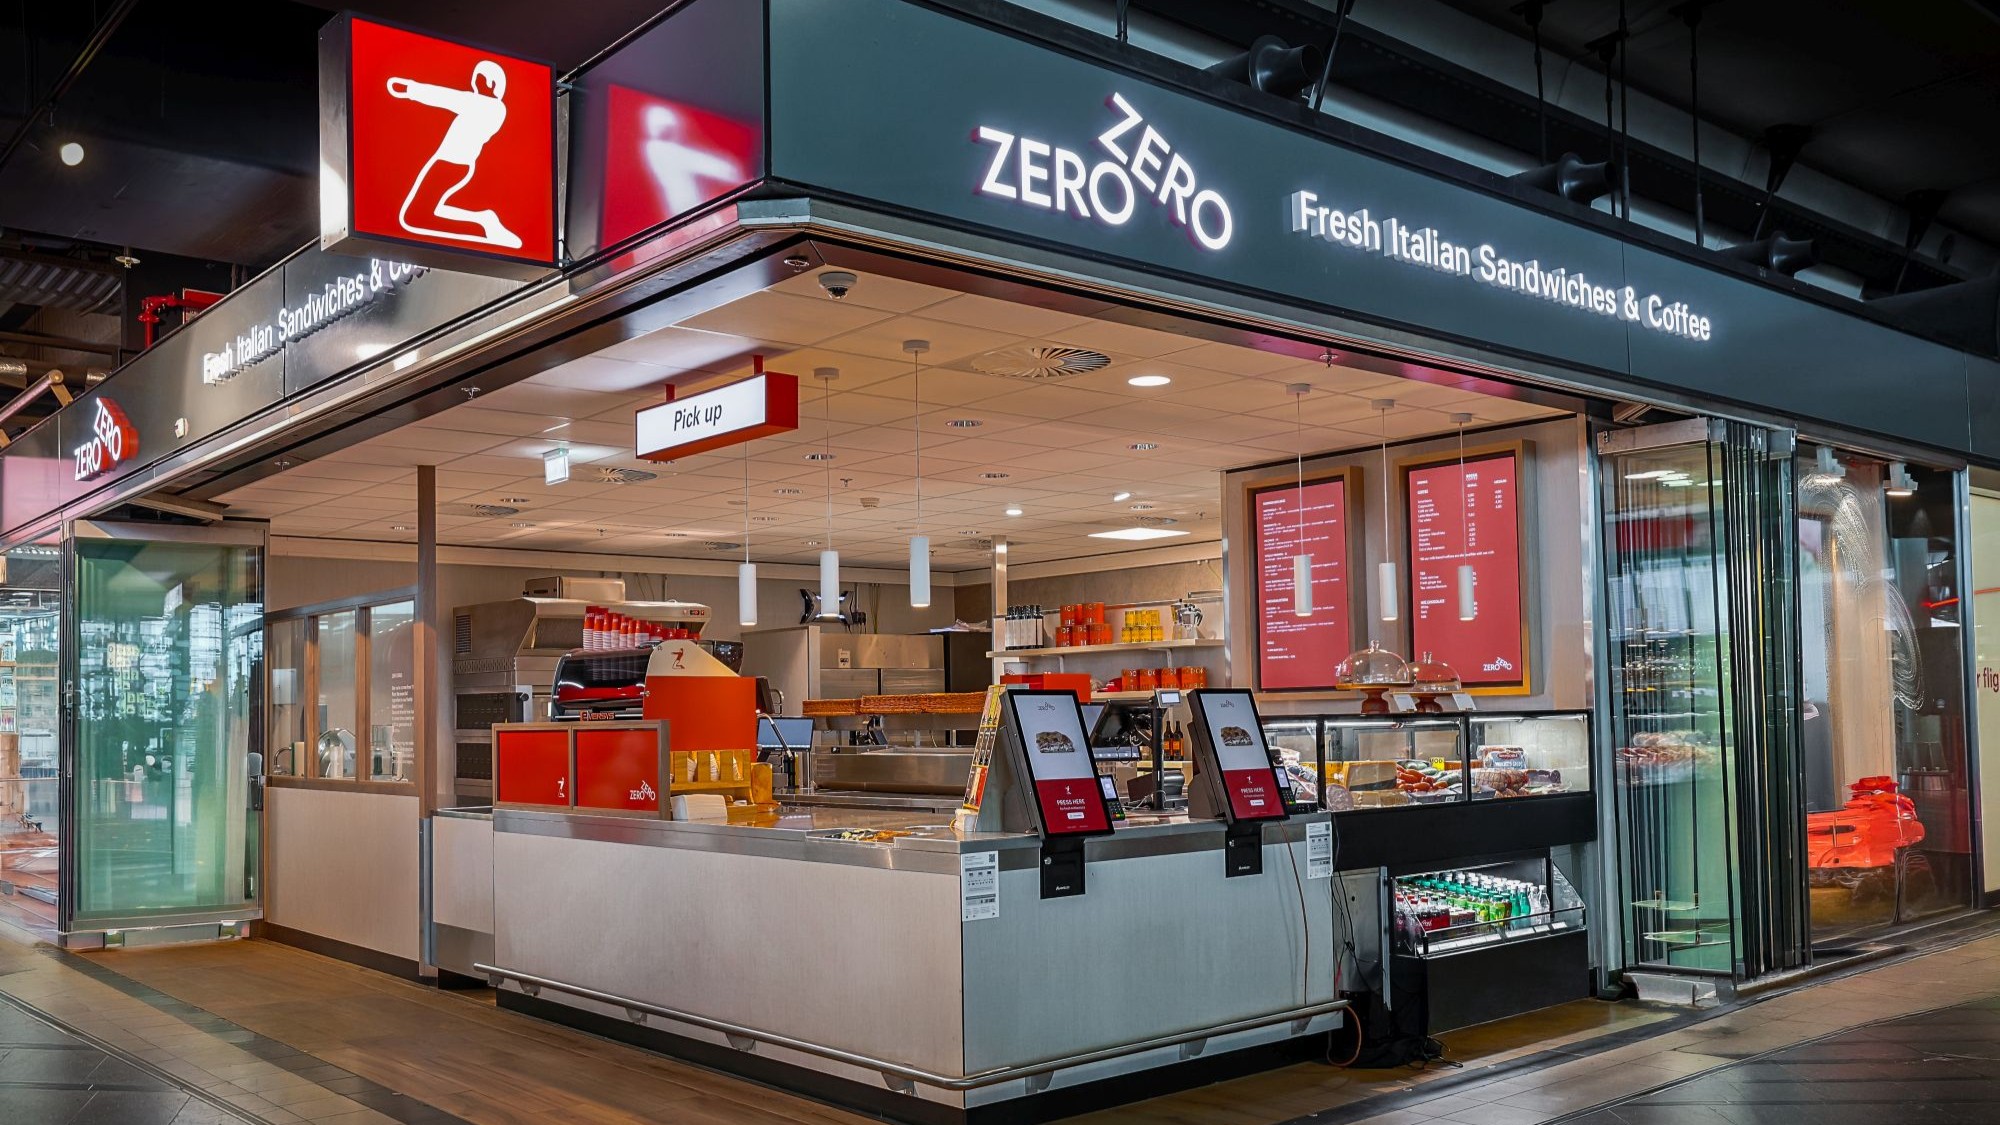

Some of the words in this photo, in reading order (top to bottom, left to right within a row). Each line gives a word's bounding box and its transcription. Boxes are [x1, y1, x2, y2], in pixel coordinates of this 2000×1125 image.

[978, 125, 1135, 225] ZERO
[1097, 91, 1233, 250] ZERO
[1294, 190, 1381, 251] Fresh
[1385, 217, 1471, 276] Italian
[1475, 244, 1617, 315] Sandwiches
[1623, 285, 1641, 321] &
[1645, 295, 1711, 341] Coffee
[236, 324, 273, 367] Italian
[278, 271, 364, 343] Sandwiches
[369, 258, 383, 293] &
[74, 436, 102, 481] ZERO
[93, 397, 122, 462] ZERO
[673, 404, 700, 432] Pick
[704, 404, 722, 426] up
[1483, 663, 1501, 672] ZERO
[629, 789, 645, 801] ZERO
[640, 779, 656, 801] ZERO
[1056, 798, 1073, 806] PRESS
